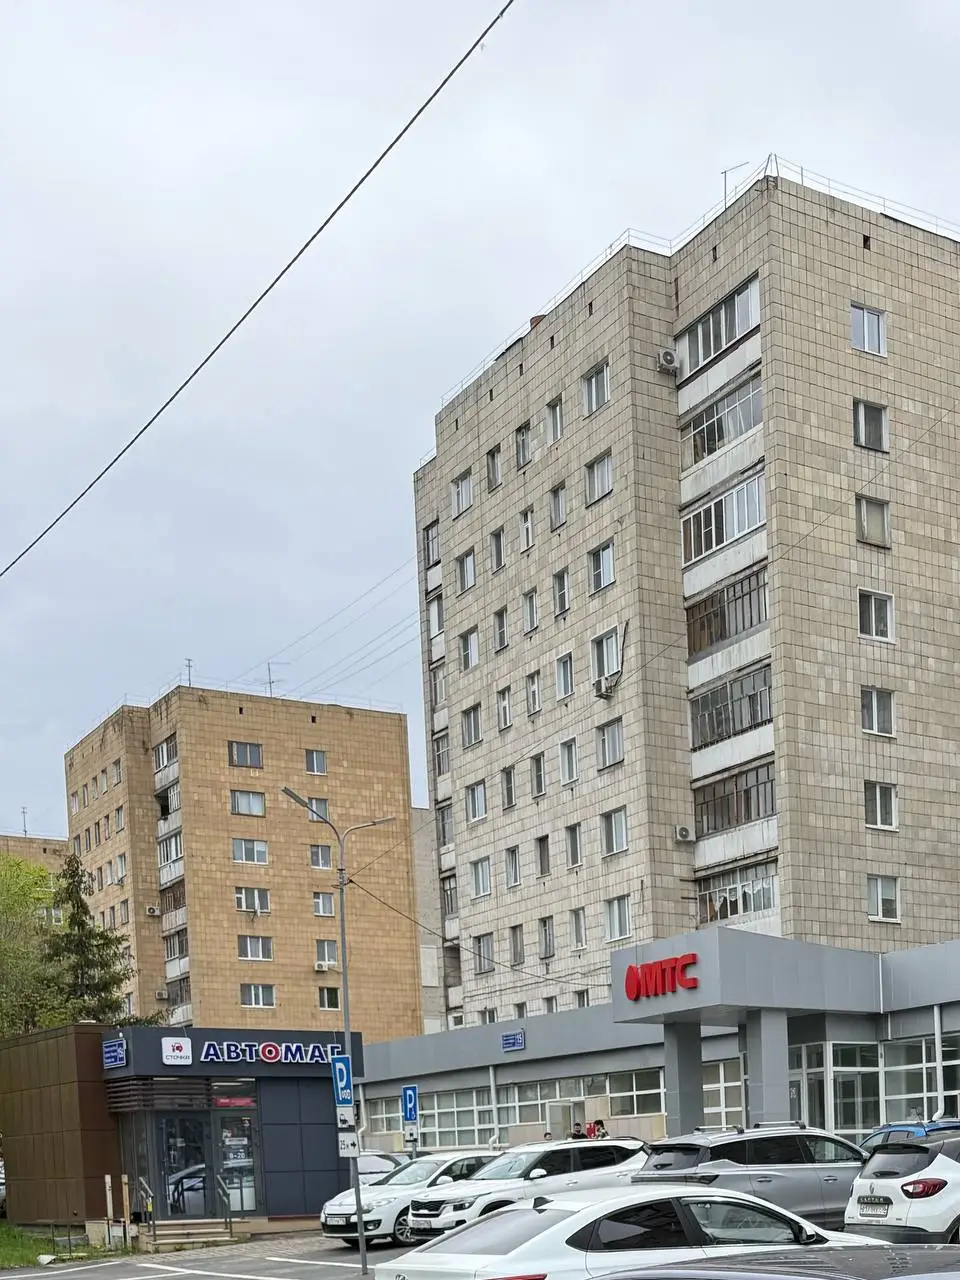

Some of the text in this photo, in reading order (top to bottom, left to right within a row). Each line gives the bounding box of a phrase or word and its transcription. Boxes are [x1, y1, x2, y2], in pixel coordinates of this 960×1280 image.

[640, 952, 699, 998] МТС
[200, 1041, 342, 1064] АВТОМАГ
[335, 1062, 347, 1101] P
[406, 1089, 415, 1119] P
